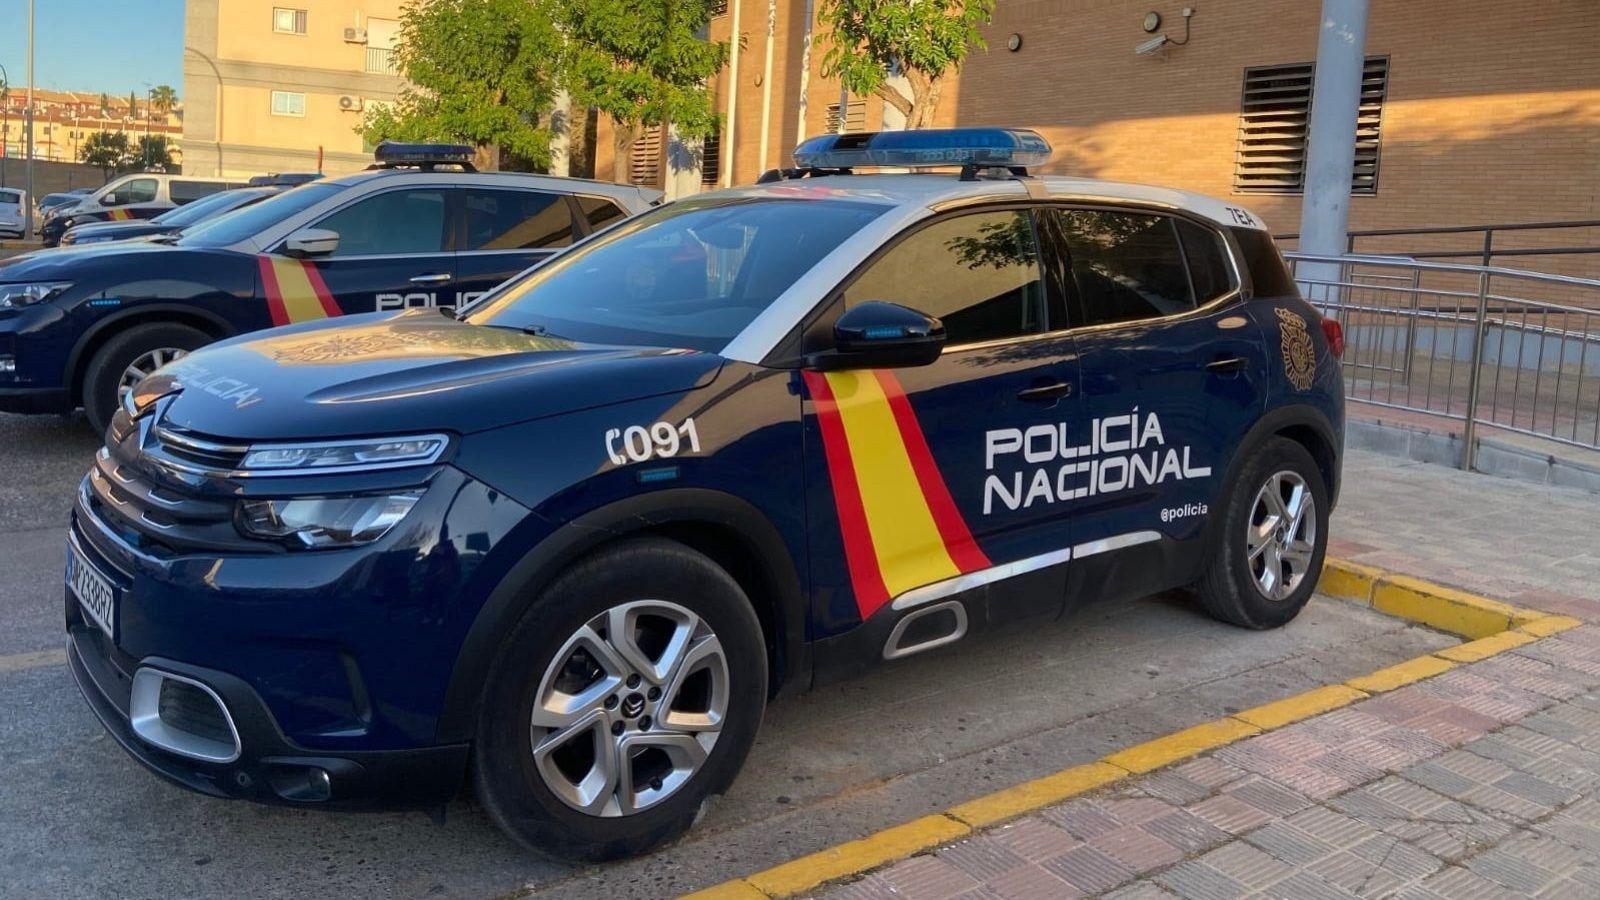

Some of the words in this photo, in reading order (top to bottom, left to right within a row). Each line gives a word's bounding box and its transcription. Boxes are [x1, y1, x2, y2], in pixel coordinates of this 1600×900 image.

[623, 417, 701, 462] 091
[985, 405, 1165, 470] POLICÍA
[983, 446, 1212, 515] NACIONAL
[1160, 503, 1208, 523] @policia
